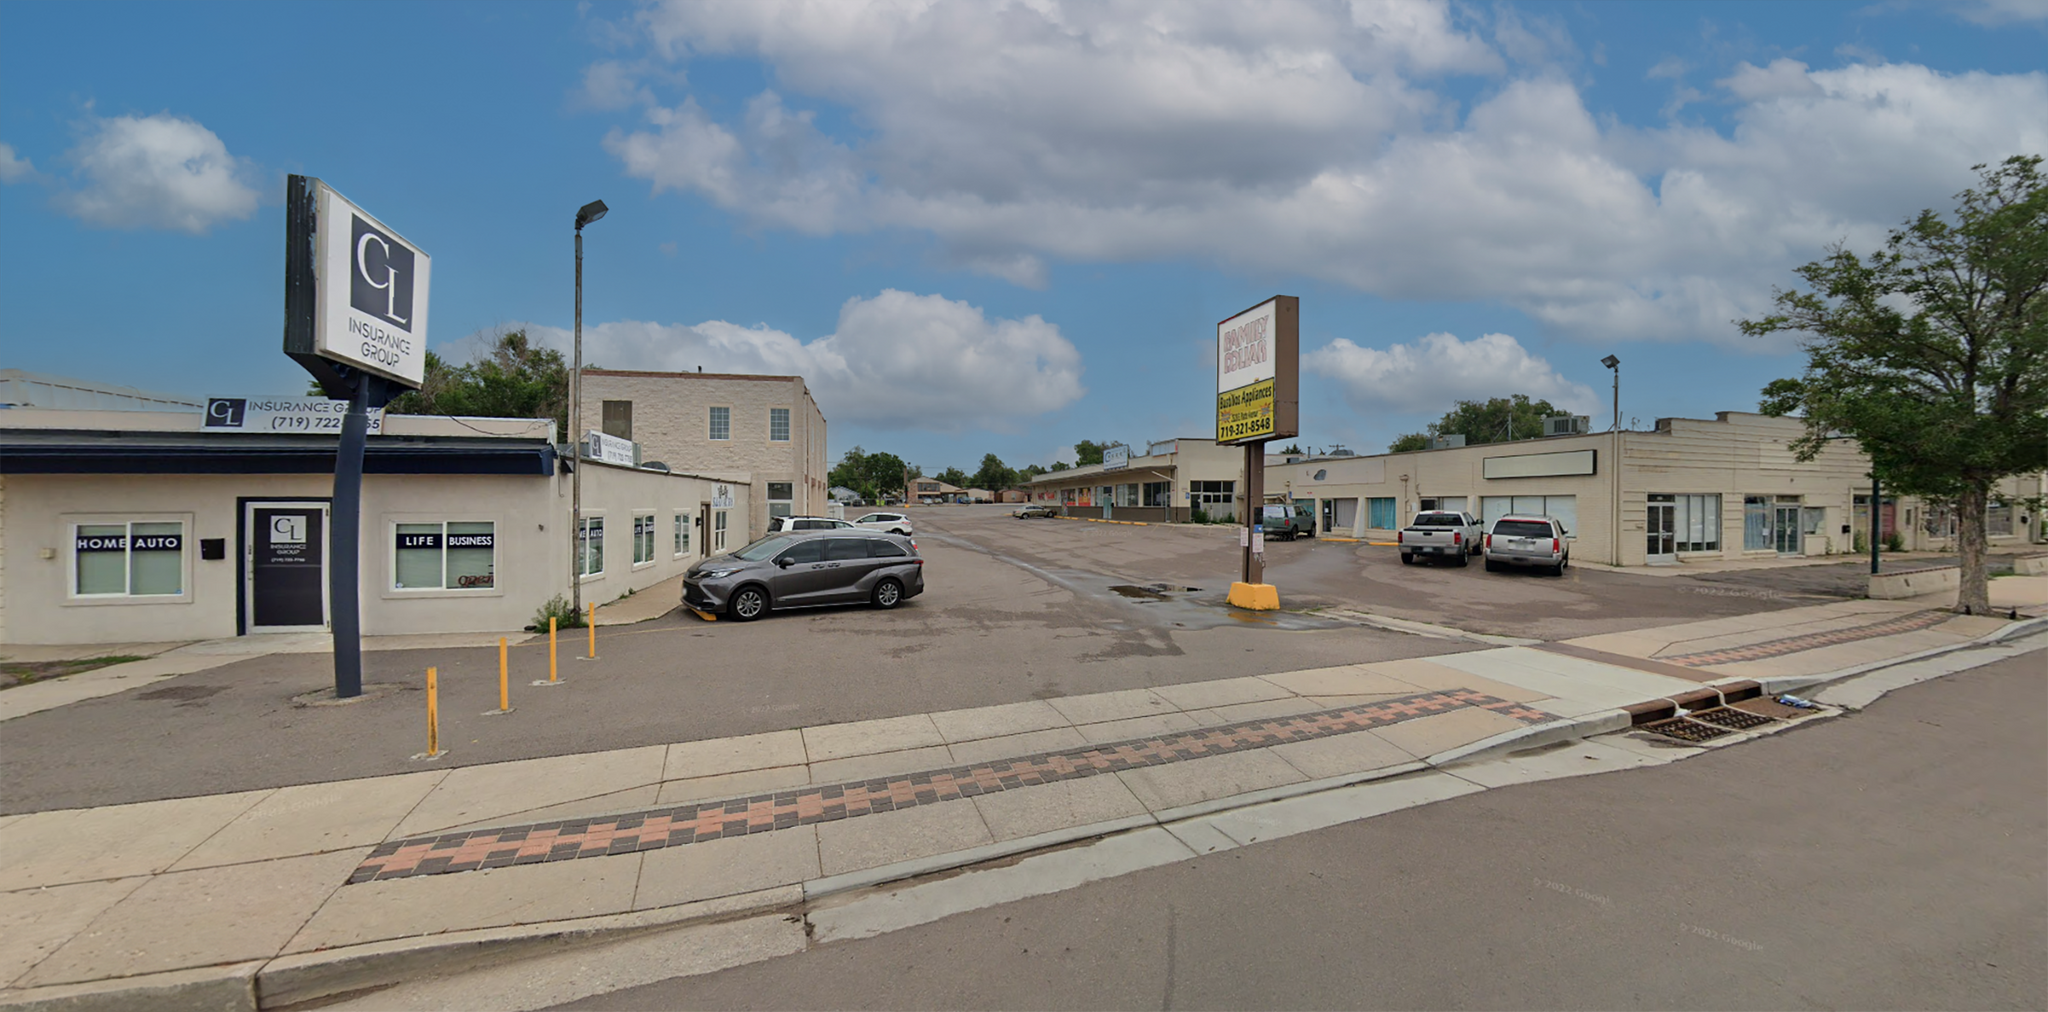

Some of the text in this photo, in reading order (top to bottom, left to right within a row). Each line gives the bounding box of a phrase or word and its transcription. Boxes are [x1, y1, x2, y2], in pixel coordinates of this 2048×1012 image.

[349, 316, 411, 356] INSURANCE
[1224, 314, 1269, 353] FAMILY
[361, 342, 400, 368] GROUP
[1224, 339, 1267, 374] DOLLAR
[248, 400, 381, 414] INSURANCE GUP
[1241, 386, 1271, 407] Appliances
[272, 416, 380, 430] (719) 722-5
[1220, 417, 1270, 438] 719-321-8548
[77, 537, 178, 549] HOME AUTO
[406, 536, 492, 546] LIFE BUSINESS
